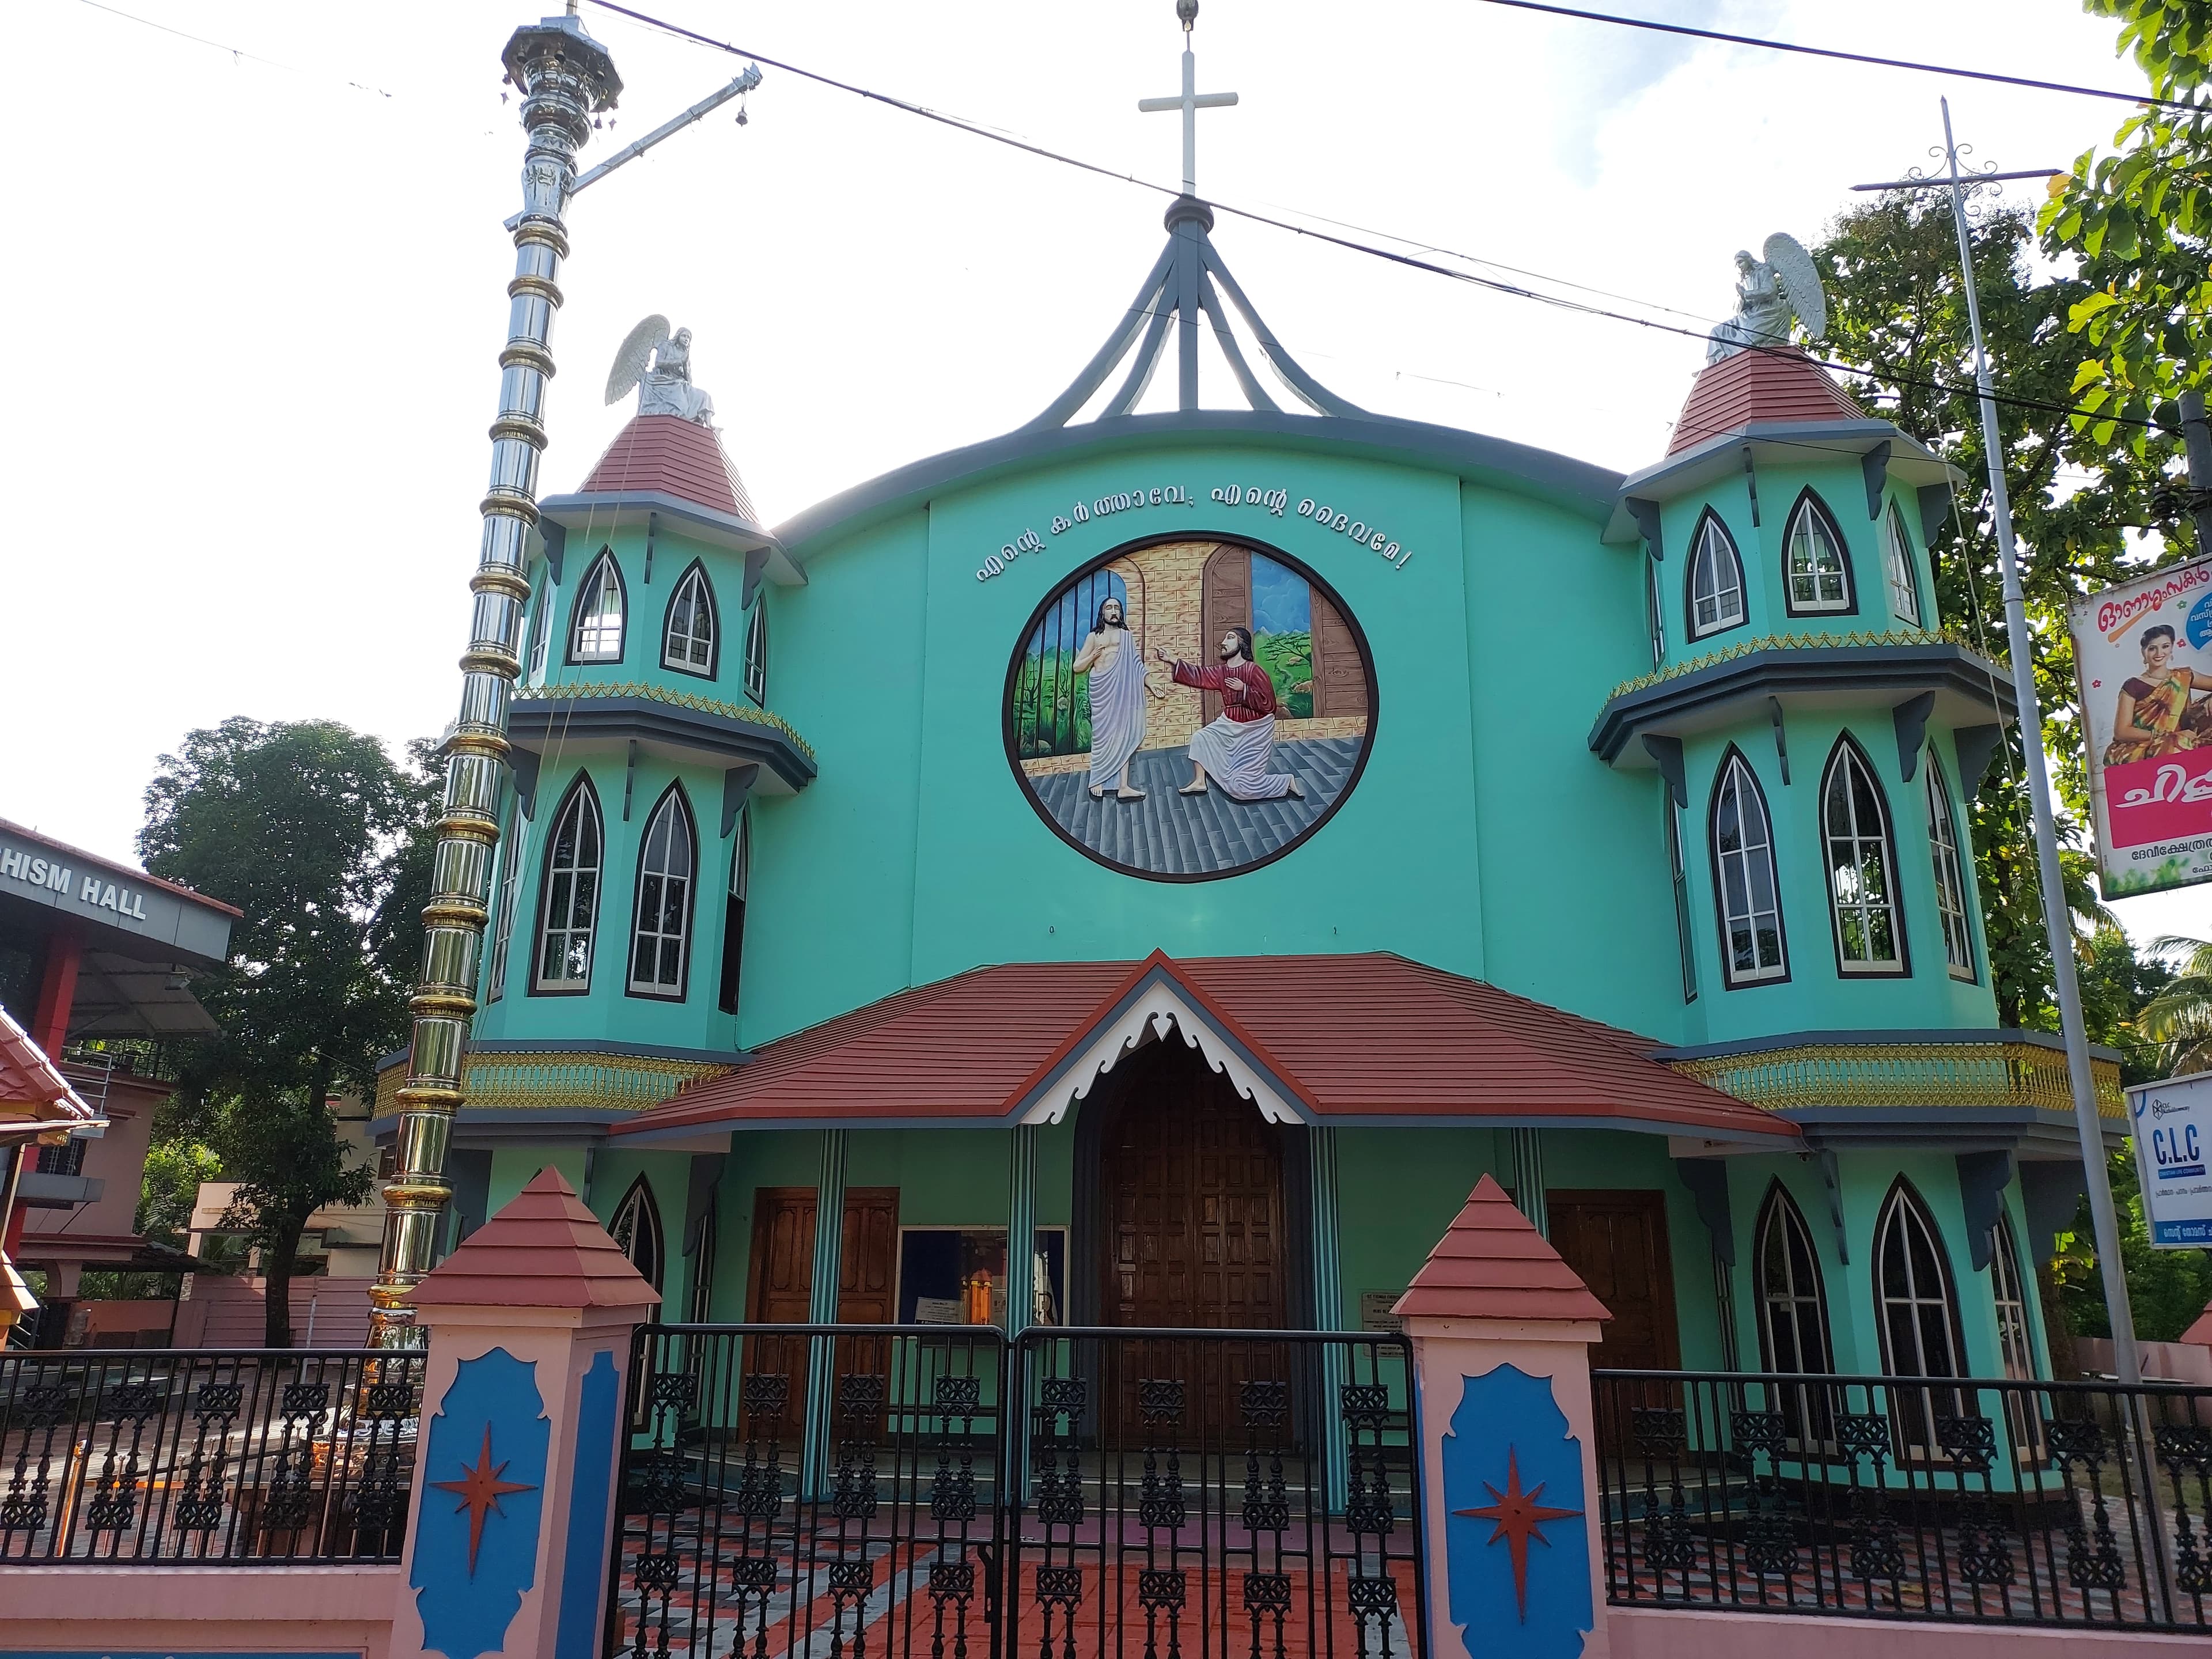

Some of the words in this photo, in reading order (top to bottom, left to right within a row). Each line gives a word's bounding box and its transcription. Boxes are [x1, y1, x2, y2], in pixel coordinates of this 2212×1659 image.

[0, 848, 71, 893] HISM
[79, 876, 146, 920] HALL
[2153, 1124, 2200, 1165] C.L.C
